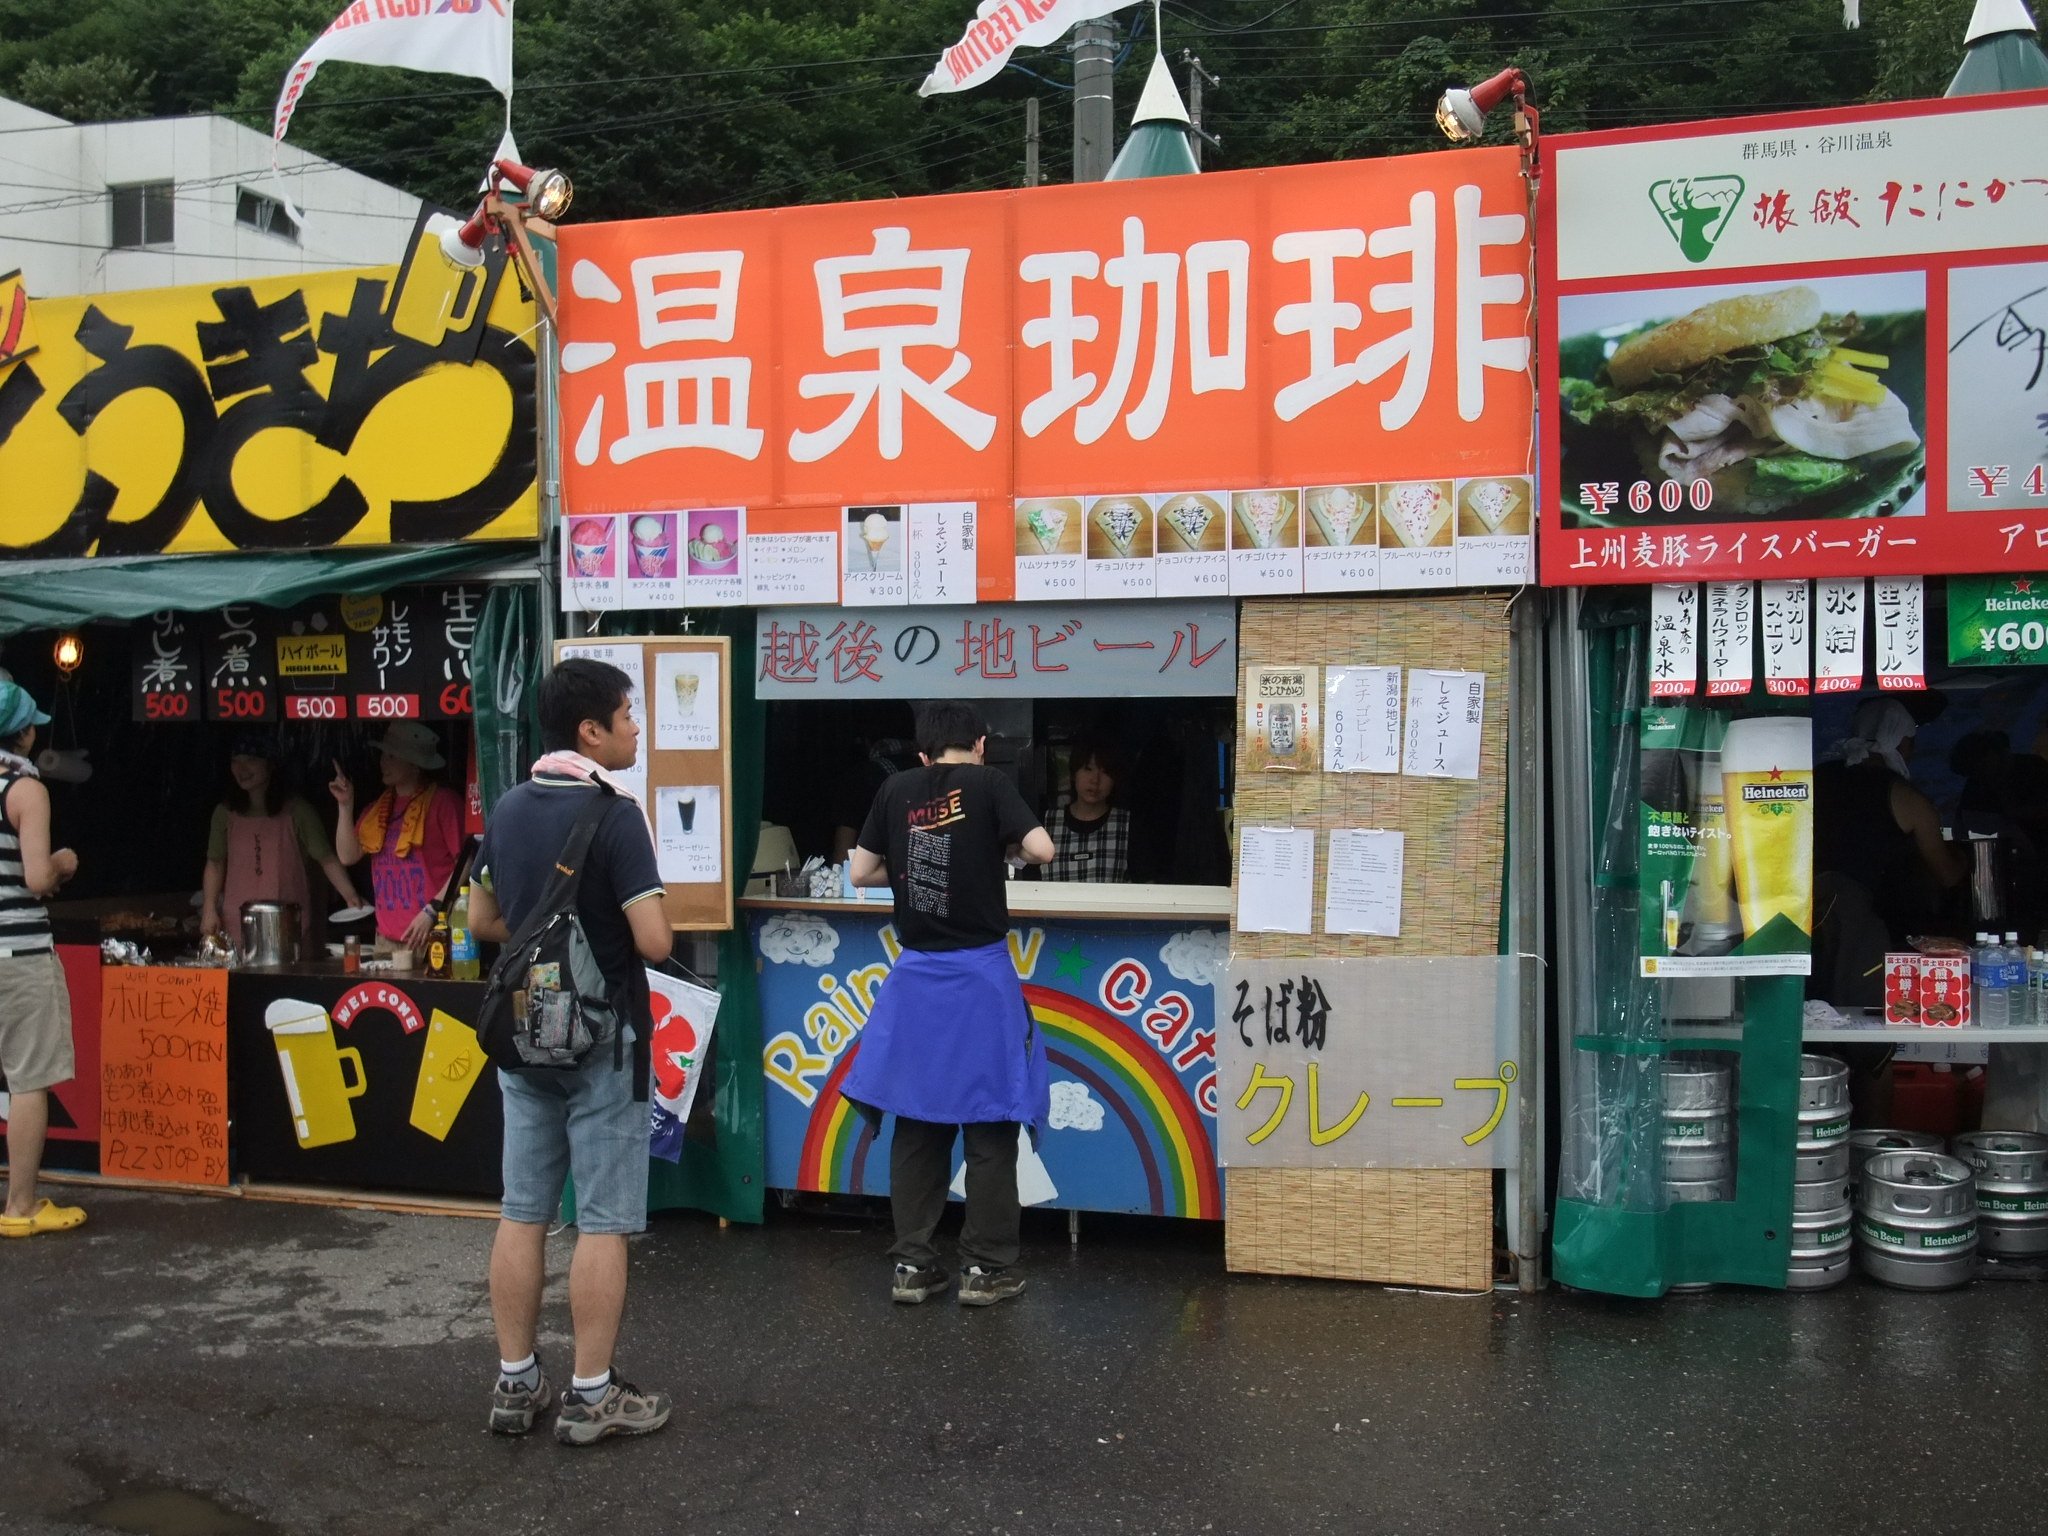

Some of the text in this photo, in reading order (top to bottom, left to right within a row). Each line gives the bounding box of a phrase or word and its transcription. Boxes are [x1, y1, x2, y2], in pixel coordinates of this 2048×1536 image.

[1742, 130, 1893, 161] 群馬県・谷川温泉
[560, 184, 1531, 465] 温泉珈琲
[1579, 477, 1714, 515] ¥600
[962, 511, 974, 551] 自家製
[935, 512, 949, 598] しそジュース
[1235, 551, 1288, 561] イチゴバナナ
[1305, 550, 1377, 560] イチゴバナナアイス
[1384, 550, 1453, 560] ブルーベリーバナナ
[1569, 525, 1917, 570] 上州麦豚ライスバーガー
[1019, 559, 1077, 570] ハムツナサラダ
[1156, 555, 1227, 565] チョコバナナアイス
[1503, 552, 1526, 561] アイス
[1095, 562, 1145, 571] チョコバナナ
[1260, 568, 1294, 578] ¥500
[1340, 568, 1374, 578] ¥600
[1420, 566, 1452, 576] ¥500
[844, 572, 904, 582] アイスクリーム
[1044, 578, 1076, 587] ¥500
[1123, 578, 1152, 587] ¥500
[1194, 574, 1227, 584] ¥600
[870, 586, 903, 595] ¥300
[1735, 587, 1749, 646] フジロック
[1825, 585, 1857, 653] 氷結
[391, 600, 412, 667] レモン
[1712, 587, 1729, 678] ミネラルウォーター
[1878, 584, 1902, 672] 生ビール
[281, 644, 342, 661] ハイボール
[759, 618, 1227, 684] 越後の地ビール
[1655, 615, 1677, 678] 温泉水
[1654, 682, 1691, 694] 200円
[1711, 681, 1746, 693] 200円
[1769, 680, 1804, 693] 300円
[1819, 678, 1857, 690] 400円
[1882, 677, 1922, 689] 600円
[146, 692, 188, 719] 500
[218, 689, 265, 718] 500
[296, 695, 336, 718] 500
[368, 695, 408, 719] 500
[1466, 682, 1480, 724] 自家製
[1354, 678, 1370, 763] エチゴビール
[1386, 672, 1399, 756] 新潟の地ビール
[660, 724, 711, 732] カフェラテゼリー
[1433, 681, 1450, 770] しそジュース
[1744, 785, 1807, 800] Heineken
[1648, 825, 1732, 839] 飽きないテイスト。
[692, 864, 717, 872] ¥500
[337, 991, 369, 1022] WEL
[1232, 975, 1332, 1050] そば粉
[1235, 1060, 1518, 1146] クレープ
[153, 1145, 199, 1173] STOP
[204, 1157, 227, 1183] BY
[1925, 1233, 1967, 1247] Heineken
